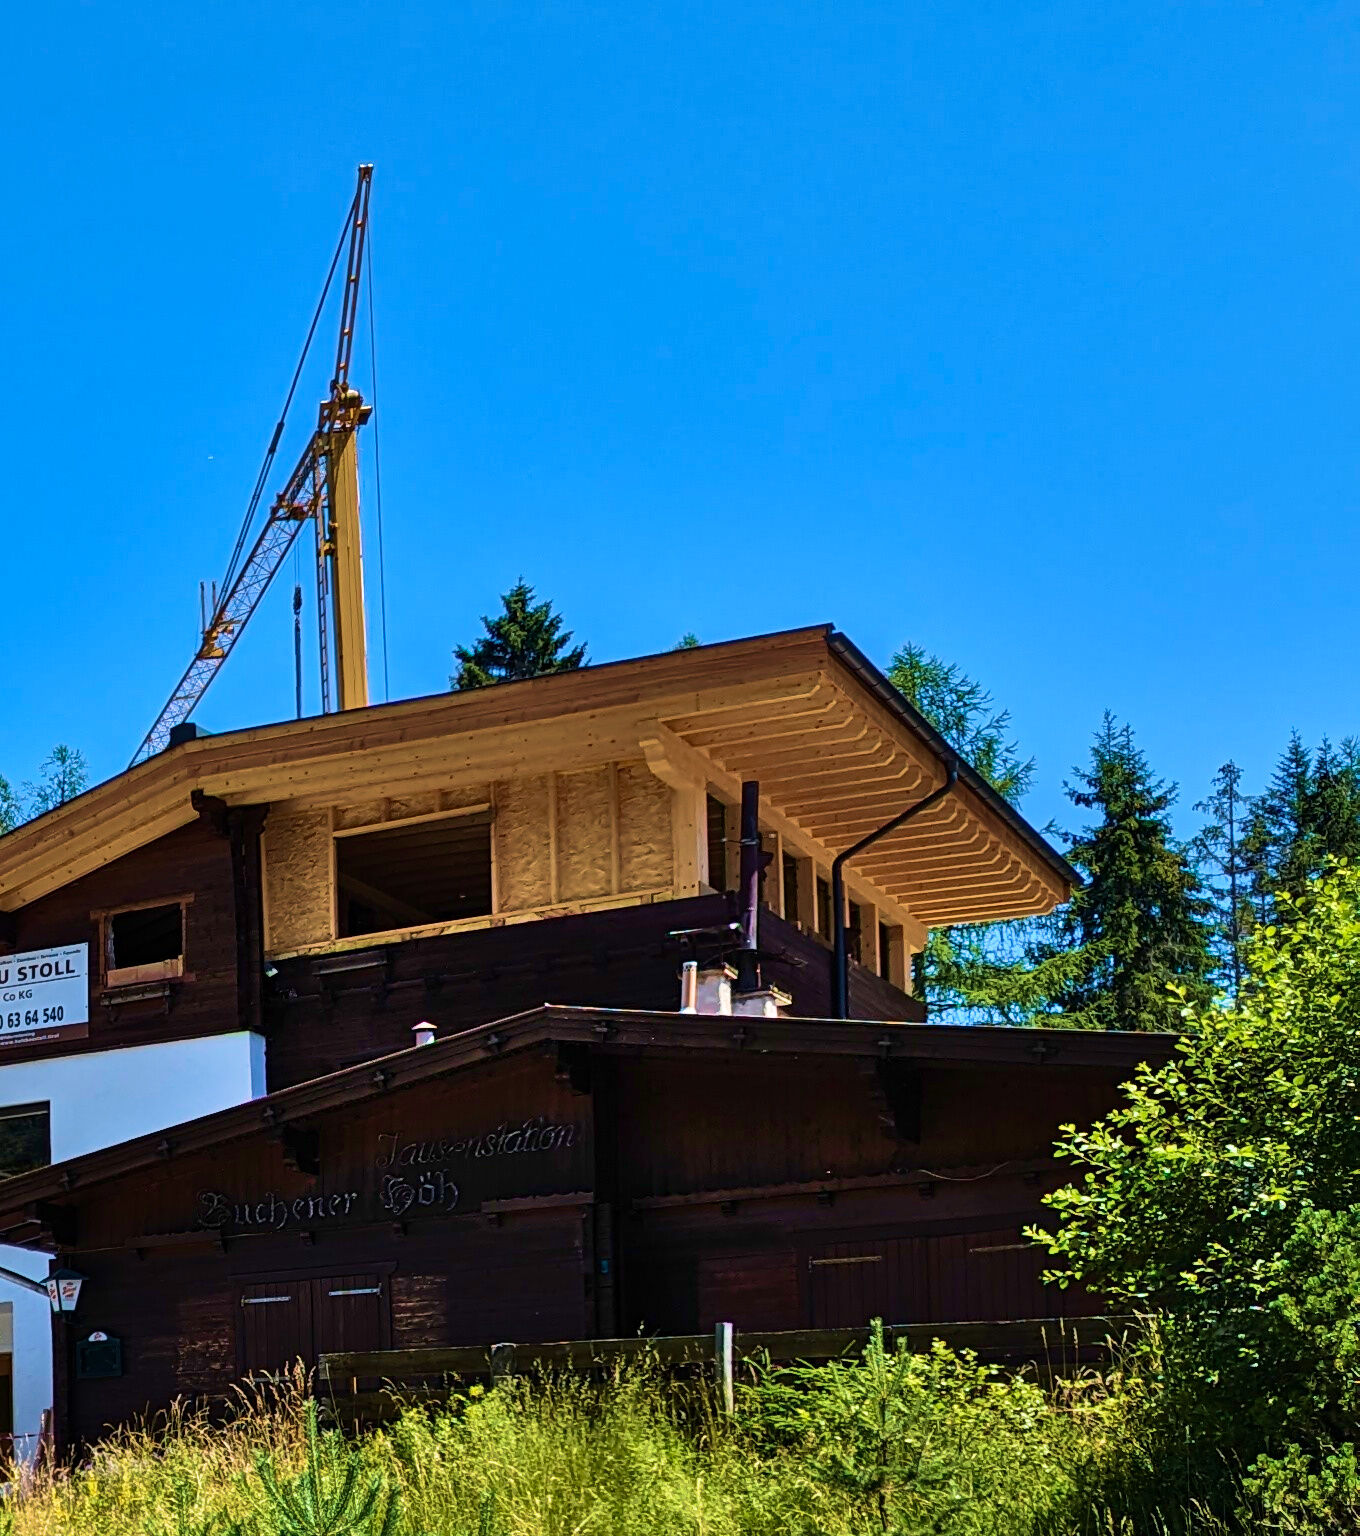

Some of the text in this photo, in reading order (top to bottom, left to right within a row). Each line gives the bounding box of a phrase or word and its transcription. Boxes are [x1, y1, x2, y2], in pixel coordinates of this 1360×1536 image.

[18, 959, 76, 982] STOLL
[3, 992, 16, 1002] Co
[18, 989, 33, 1000] KG
[7, 1012, 21, 1029] 63
[24, 1009, 39, 1026] 64
[43, 1005, 64, 1024] 540
